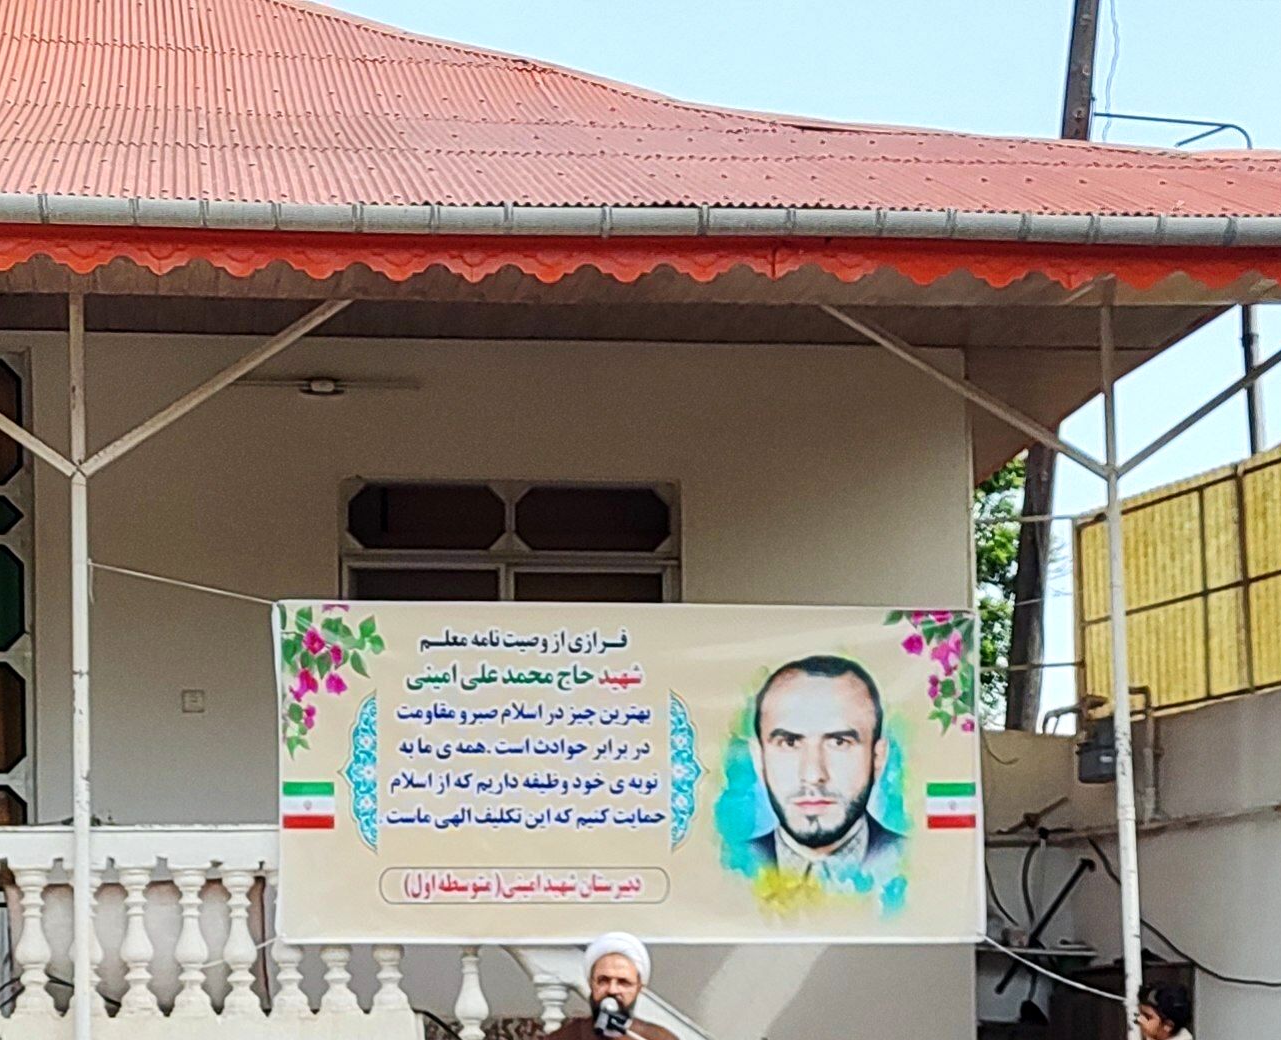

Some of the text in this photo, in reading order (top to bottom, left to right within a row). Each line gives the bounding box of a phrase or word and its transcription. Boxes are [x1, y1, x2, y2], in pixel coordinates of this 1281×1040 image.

[472, 630, 500, 649] نامه
[503, 632, 548, 653] وصیت
[552, 631, 565, 653] از
[407, 665, 642, 690] شهید حاج محمد علی امینی
[397, 703, 650, 726] بهترین چیز در اسلام صبر و مقاومت
[399, 739, 415, 757] به
[418, 737, 431, 754] ما
[534, 739, 587, 760] حوادث
[595, 740, 628, 760] برابر
[633, 740, 650, 760] در
[390, 773, 432, 793] اسلام
[437, 773, 450, 794] از
[454, 773, 472, 788] که
[476, 773, 518, 794] داریم
[523, 773, 568, 794] وظیفه
[572, 776, 604, 794] خود
[628, 778, 658, 794] نوبه
[434, 810, 471, 829] الهی
[475, 808, 522, 828] تکلیف
[525, 810, 551, 829] این
[555, 808, 572, 823] که
[576, 808, 609, 828] کنیم
[613, 810, 665, 828] حمایت
[544, 874, 576, 898] شهید
[580, 873, 640, 899] دبیرستان
